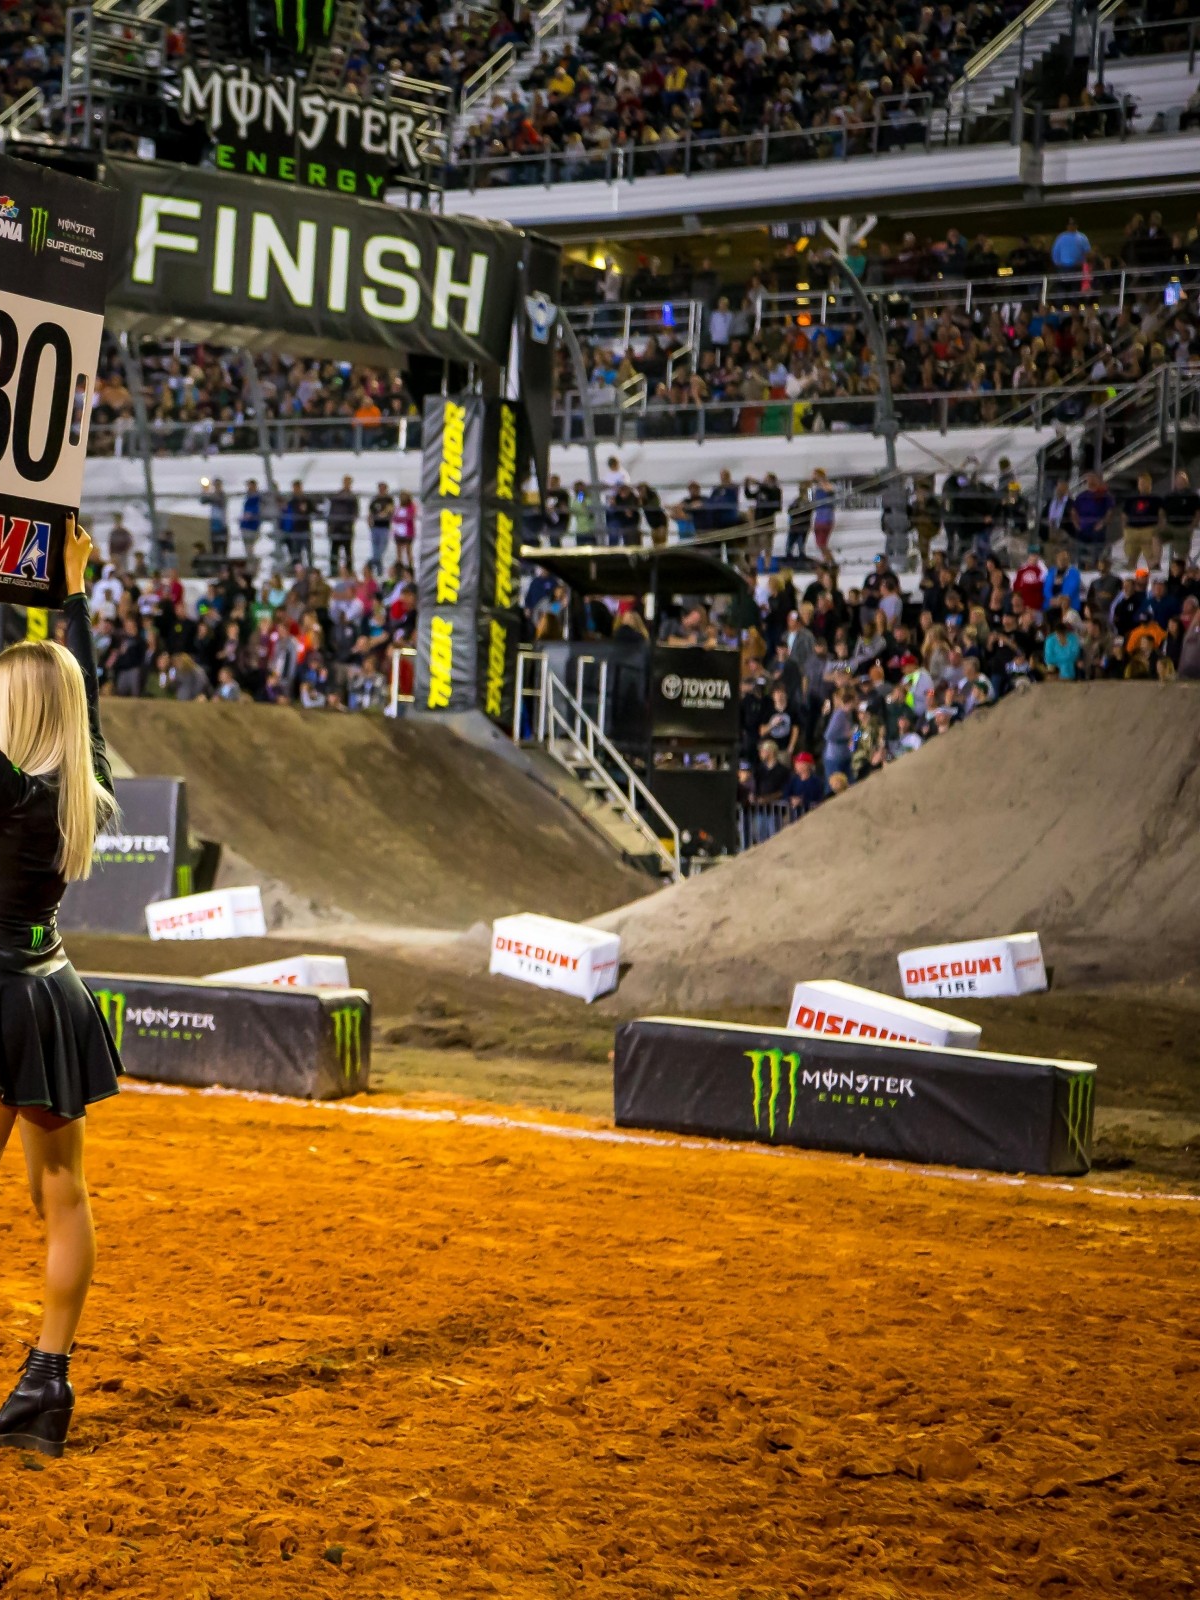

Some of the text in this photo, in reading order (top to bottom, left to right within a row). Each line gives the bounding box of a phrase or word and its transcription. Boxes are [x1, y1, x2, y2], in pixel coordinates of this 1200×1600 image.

[181, 66, 422, 169] MONSTER
[216, 144, 385, 197] ENERGY
[57, 218, 96, 238] MONSTER
[46, 238, 104, 261] SUPERCROSS
[131, 193, 489, 335] FINISH
[439, 400, 466, 497] THOR
[496, 403, 516, 500] THOR
[437, 508, 463, 605] THOR
[494, 511, 514, 609] THOR
[428, 615, 453, 709] THOR
[486, 619, 506, 716] THOR
[682, 678, 731, 699] TOYOTA
[95, 835, 170, 853] ONSTER
[496, 937, 580, 971] DISCOUNT
[906, 956, 1003, 984] DISCOUNT
[936, 980, 979, 996] TIRE
[125, 1006, 216, 1031] MONSTER
[802, 1068, 915, 1098] MONSTER
[818, 1092, 897, 1108] ENERGY
